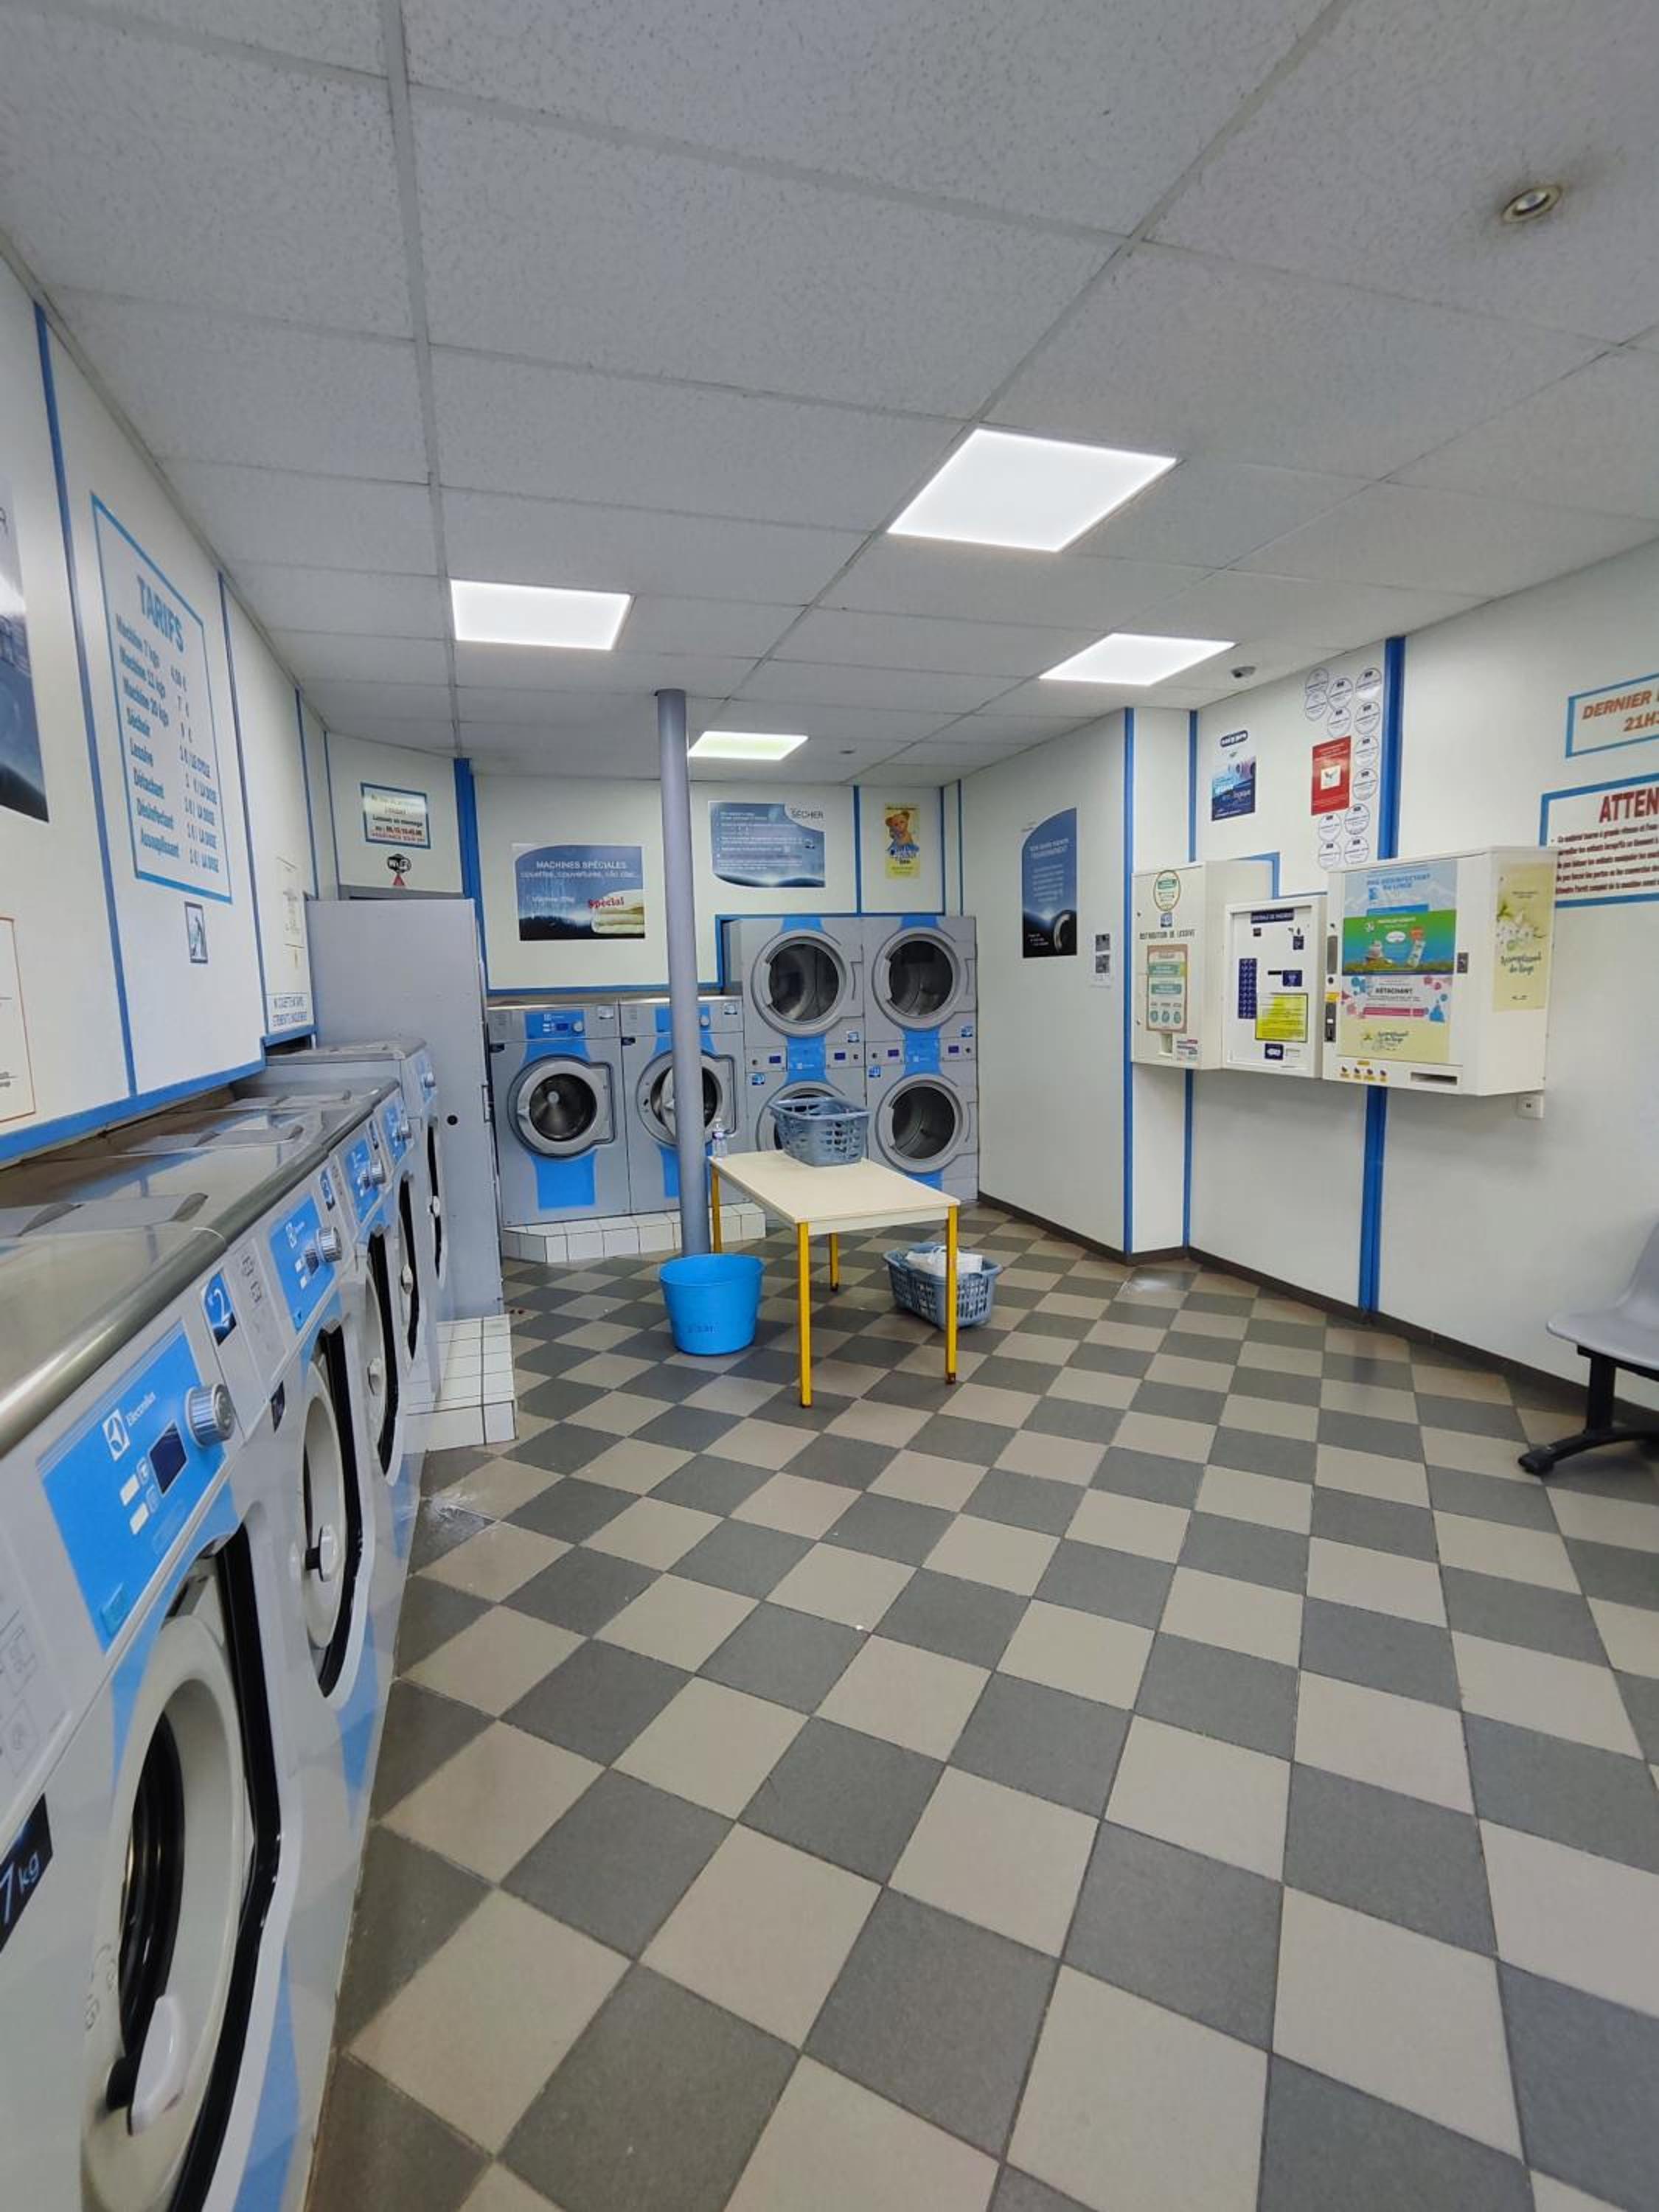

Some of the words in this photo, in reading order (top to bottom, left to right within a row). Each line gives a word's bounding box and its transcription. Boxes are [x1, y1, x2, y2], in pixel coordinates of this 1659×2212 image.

[137, 575, 184, 653] TARIFS
[1582, 690, 1652, 720] DERNIER
[536, 860, 580, 869] MACHINES
[18, 1851, 41, 1895] kg
